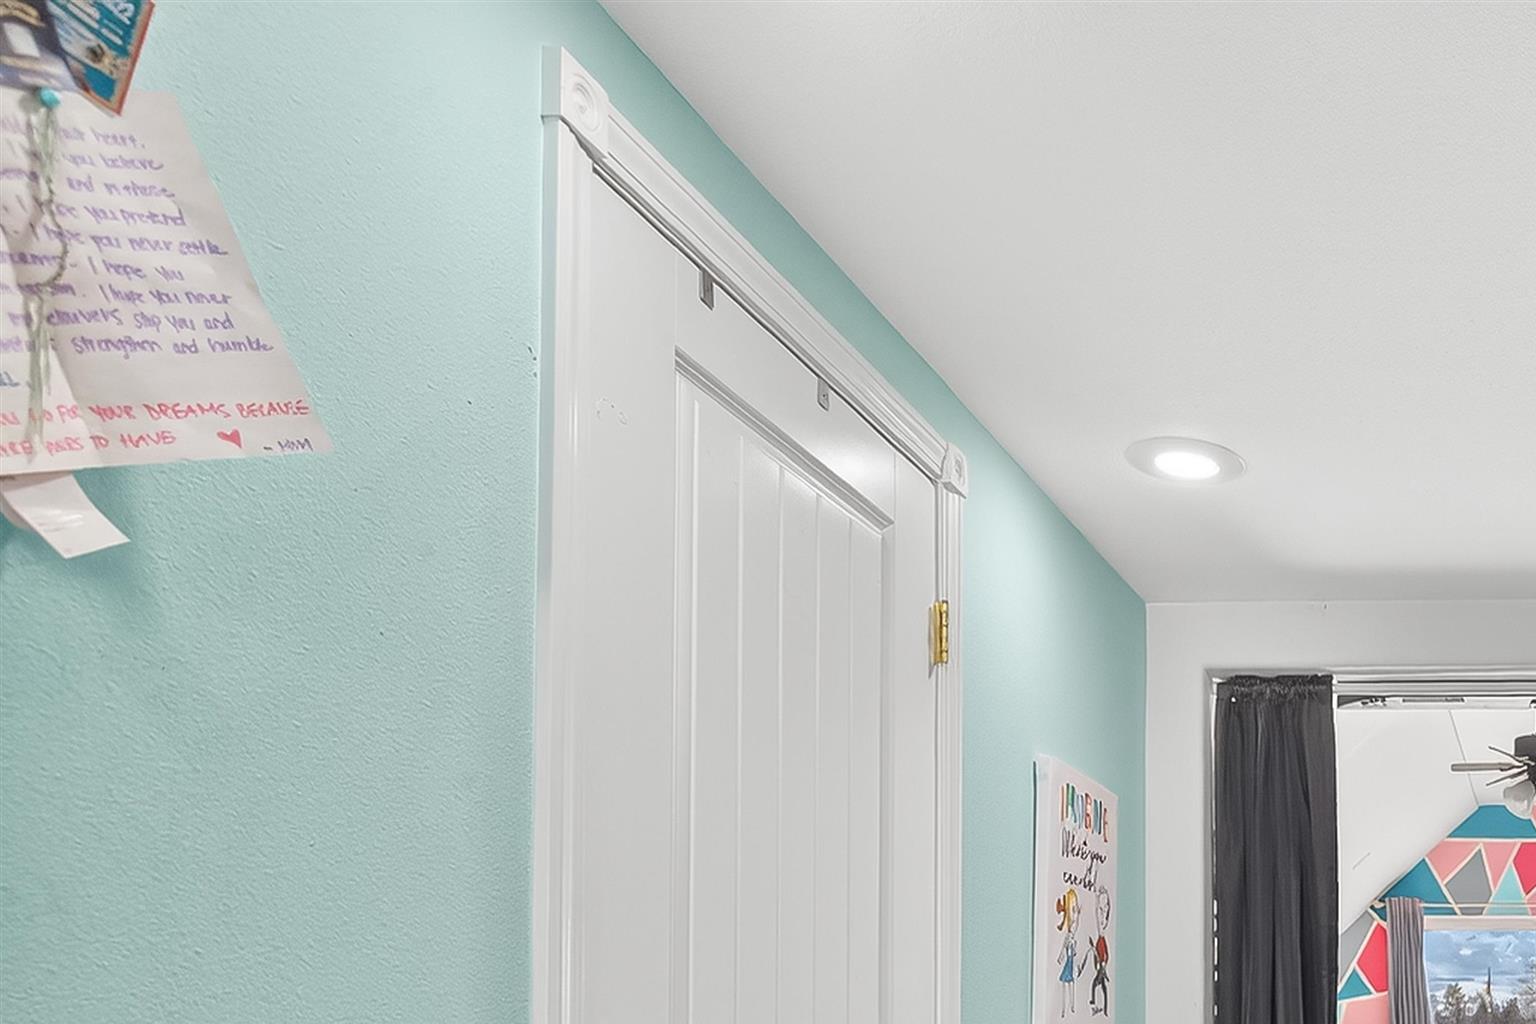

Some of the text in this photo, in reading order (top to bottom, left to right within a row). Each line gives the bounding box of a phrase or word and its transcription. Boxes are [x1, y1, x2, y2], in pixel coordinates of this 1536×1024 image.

[89, 235, 120, 252] you
[128, 237, 173, 252] never
[102, 258, 146, 280] hope
[109, 283, 145, 306] hope
[185, 290, 232, 305] never
[134, 311, 161, 333] stop
[203, 311, 235, 330] and
[173, 337, 199, 355] and
[207, 335, 275, 352] humble
[88, 403, 136, 423] YOUR
[142, 401, 231, 421] DREAMS
[236, 399, 310, 418] BECAUSE
[89, 434, 110, 450] TO
[118, 430, 176, 449] HAVE
